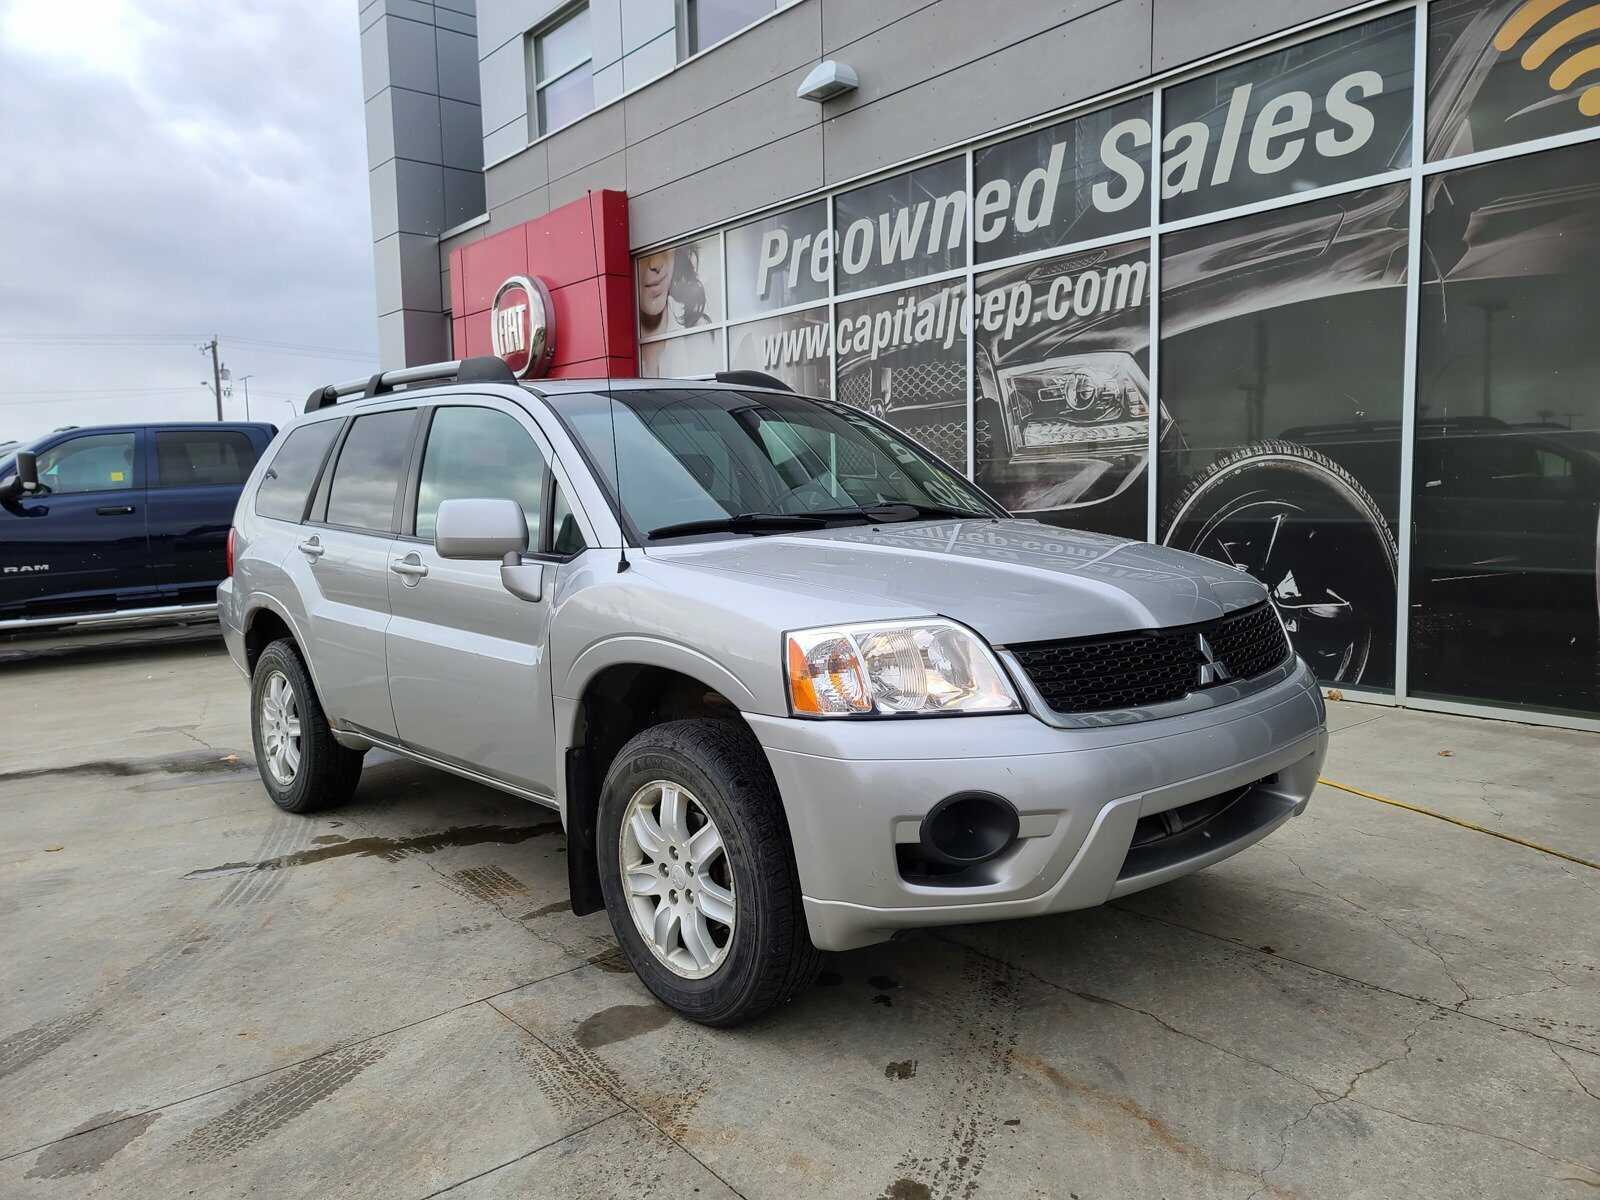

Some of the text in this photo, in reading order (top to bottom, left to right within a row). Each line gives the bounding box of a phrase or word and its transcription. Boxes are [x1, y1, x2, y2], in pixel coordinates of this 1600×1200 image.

[756, 70, 1384, 296] Preowned Sales
[499, 303, 527, 355] FIAT
[3, 564, 49, 573] RAM
